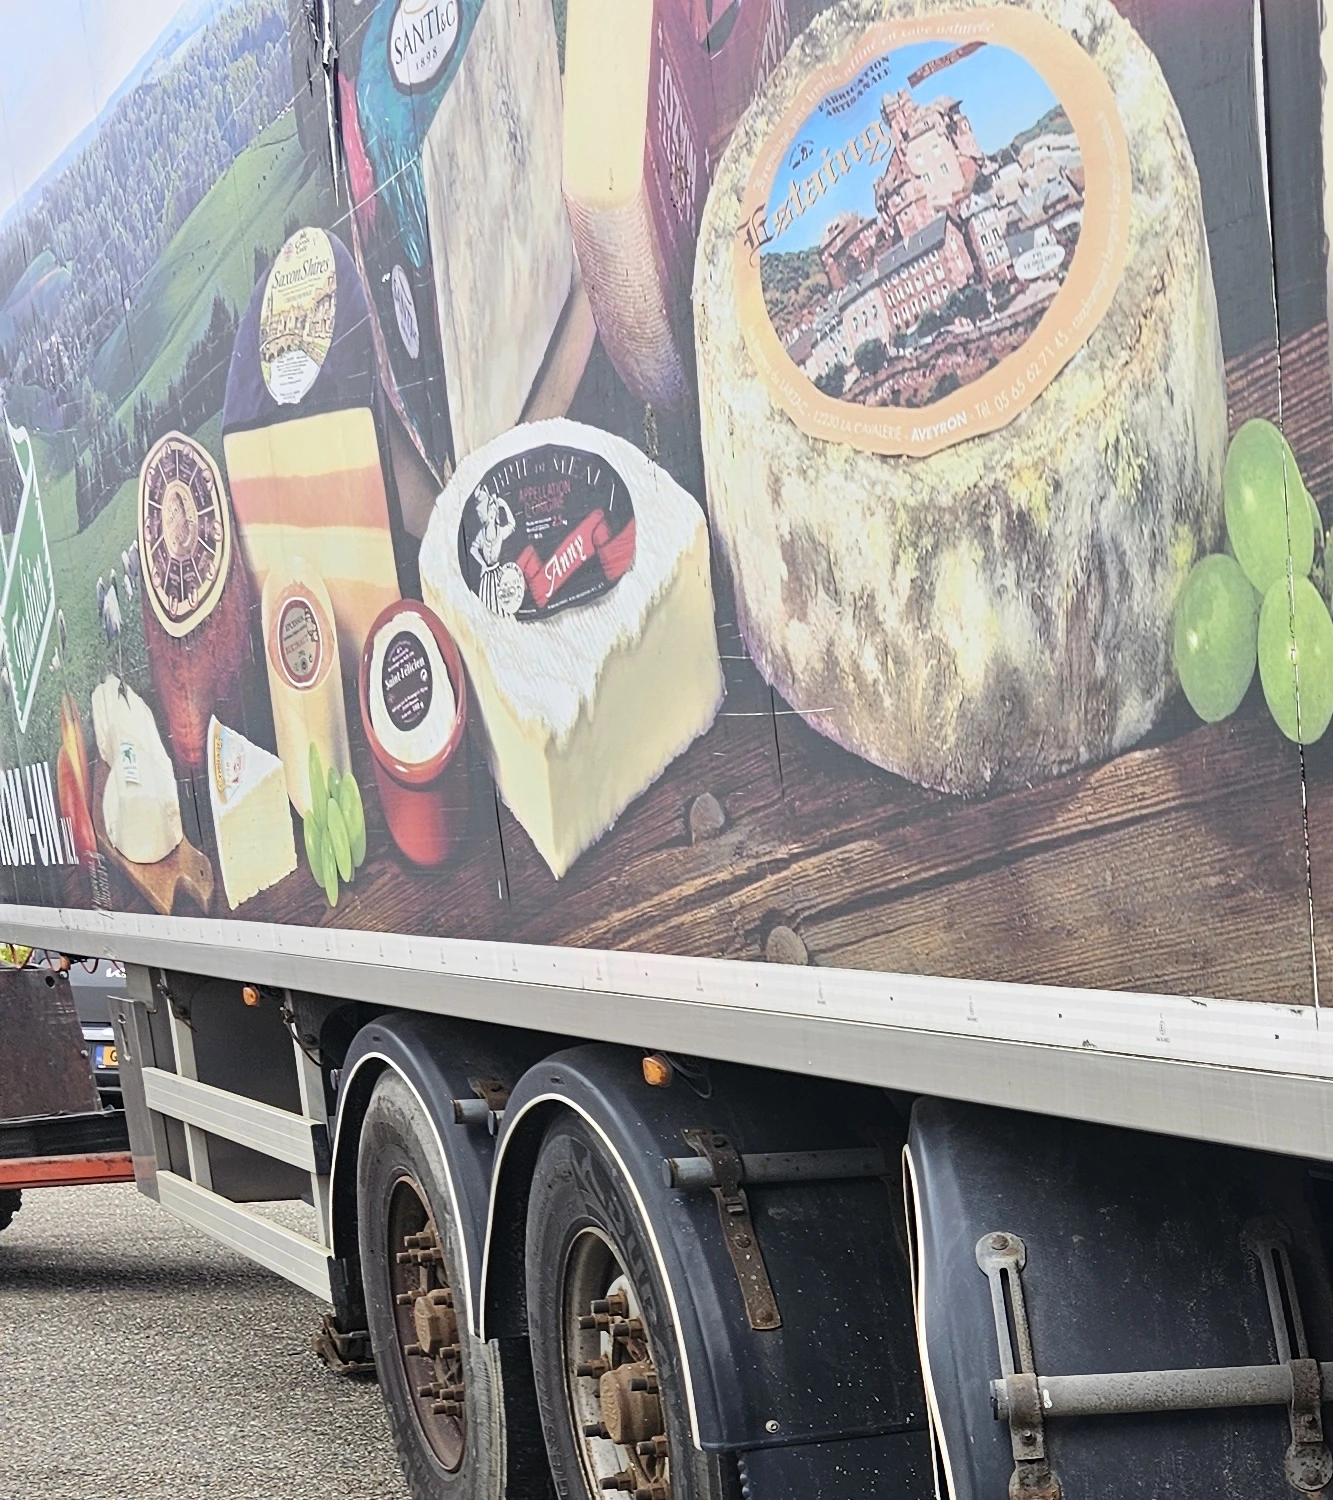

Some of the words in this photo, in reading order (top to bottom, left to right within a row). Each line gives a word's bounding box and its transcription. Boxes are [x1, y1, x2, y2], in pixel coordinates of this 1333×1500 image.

[415, 45, 438, 71] 1898
[818, 55, 890, 113] FABRICATION
[272, 268, 301, 289] Saxon
[301, 256, 329, 283] Shires
[910, 410, 968, 443] AVEYRON
[994, 390, 1010, 412] 05
[1011, 376, 1026, 398] 65
[1027, 362, 1043, 384] 62
[544, 534, 588, 599] Anny
